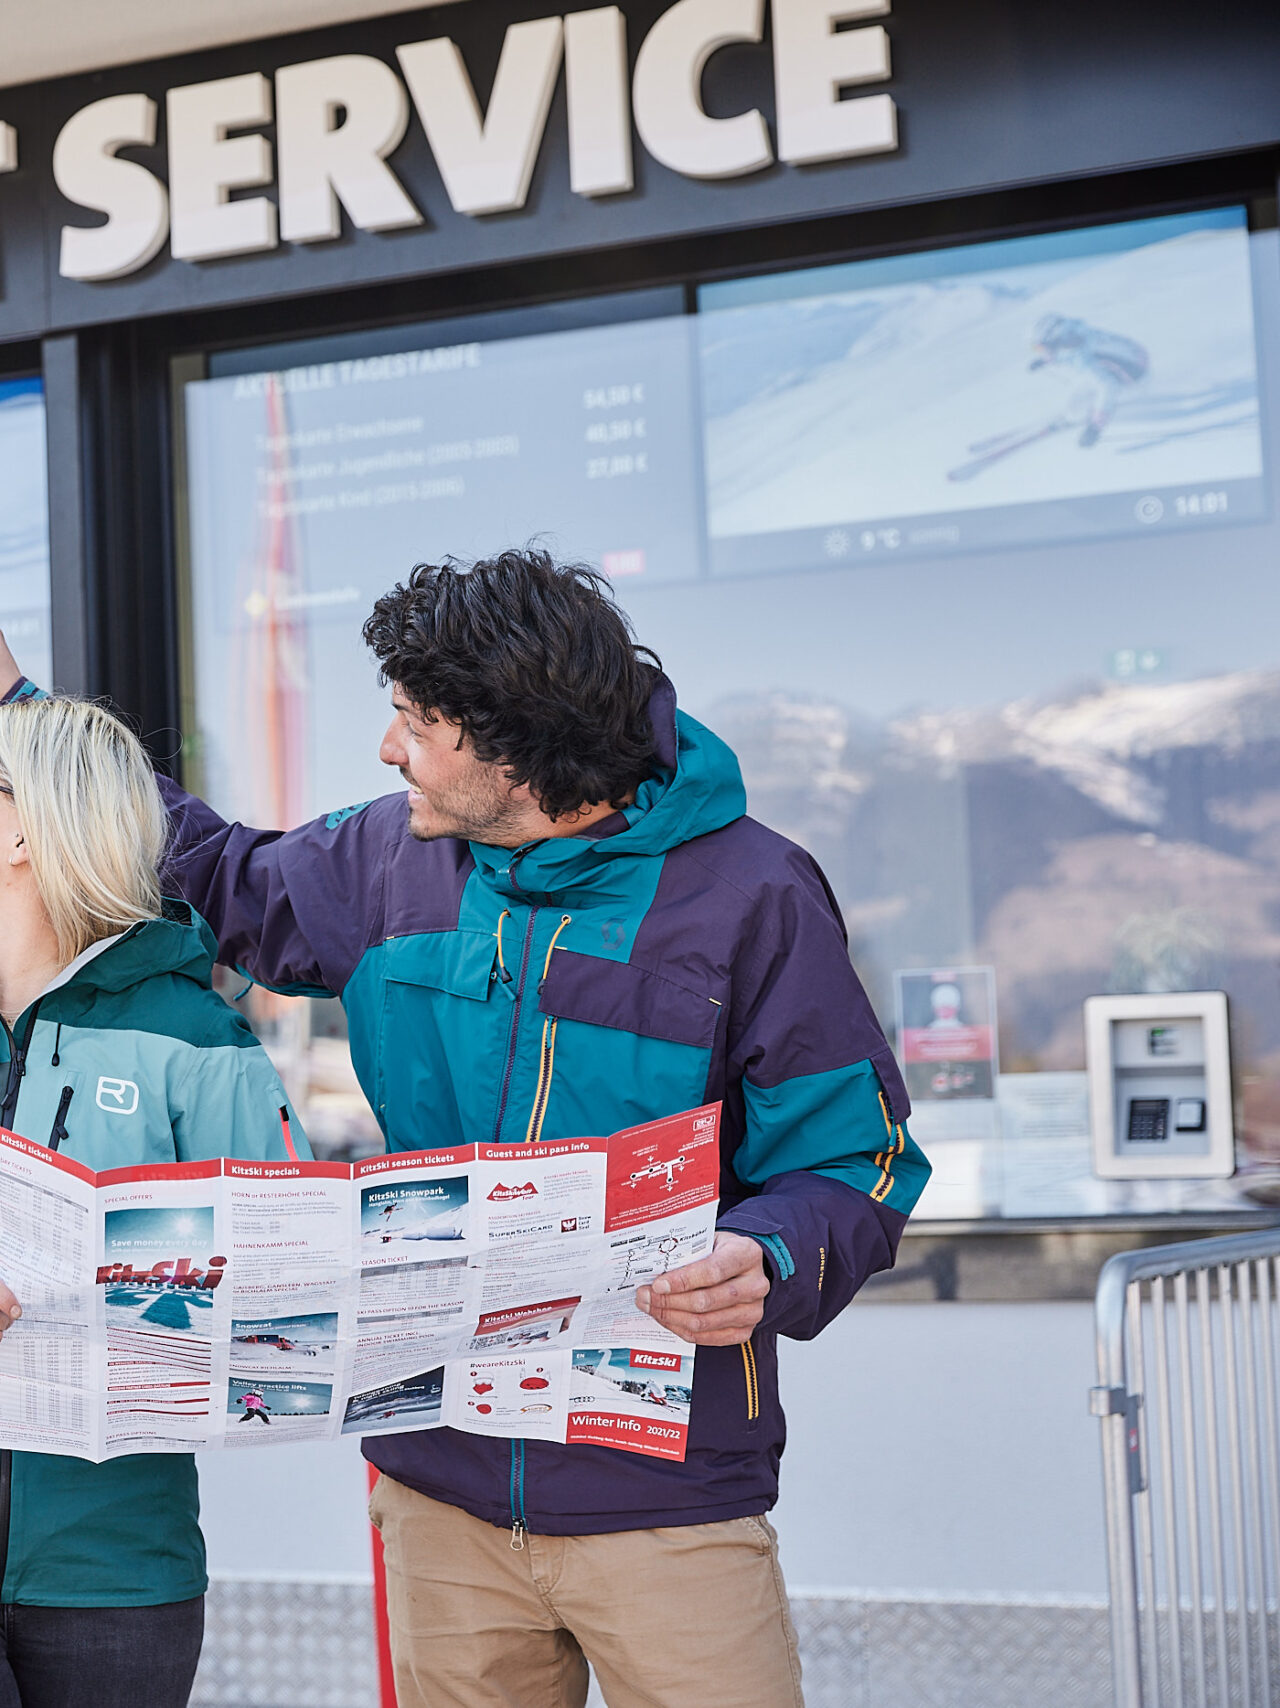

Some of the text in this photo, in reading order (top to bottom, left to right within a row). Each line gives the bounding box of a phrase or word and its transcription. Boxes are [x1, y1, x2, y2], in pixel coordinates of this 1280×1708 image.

[53, 0, 899, 284] SERVICE
[1, 1133, 53, 1162] KitzSki tickets
[486, 1142, 590, 1158] Guest and ski pass info
[360, 1154, 454, 1174] KitzSki season tickets
[231, 1165, 300, 1178] KitzSki specials
[301, 1189, 327, 1197] SPECIAL
[368, 1186, 444, 1202] KitzSki Snowpark
[104, 1196, 128, 1204] SPECIAL
[133, 1240, 163, 1249] money
[361, 1258, 386, 1266] SEASON
[470, 1359, 526, 1368] #weareKitzSki
[634, 1354, 677, 1367] KitzSki
[572, 1415, 680, 1440] Winter Info 2021/22
